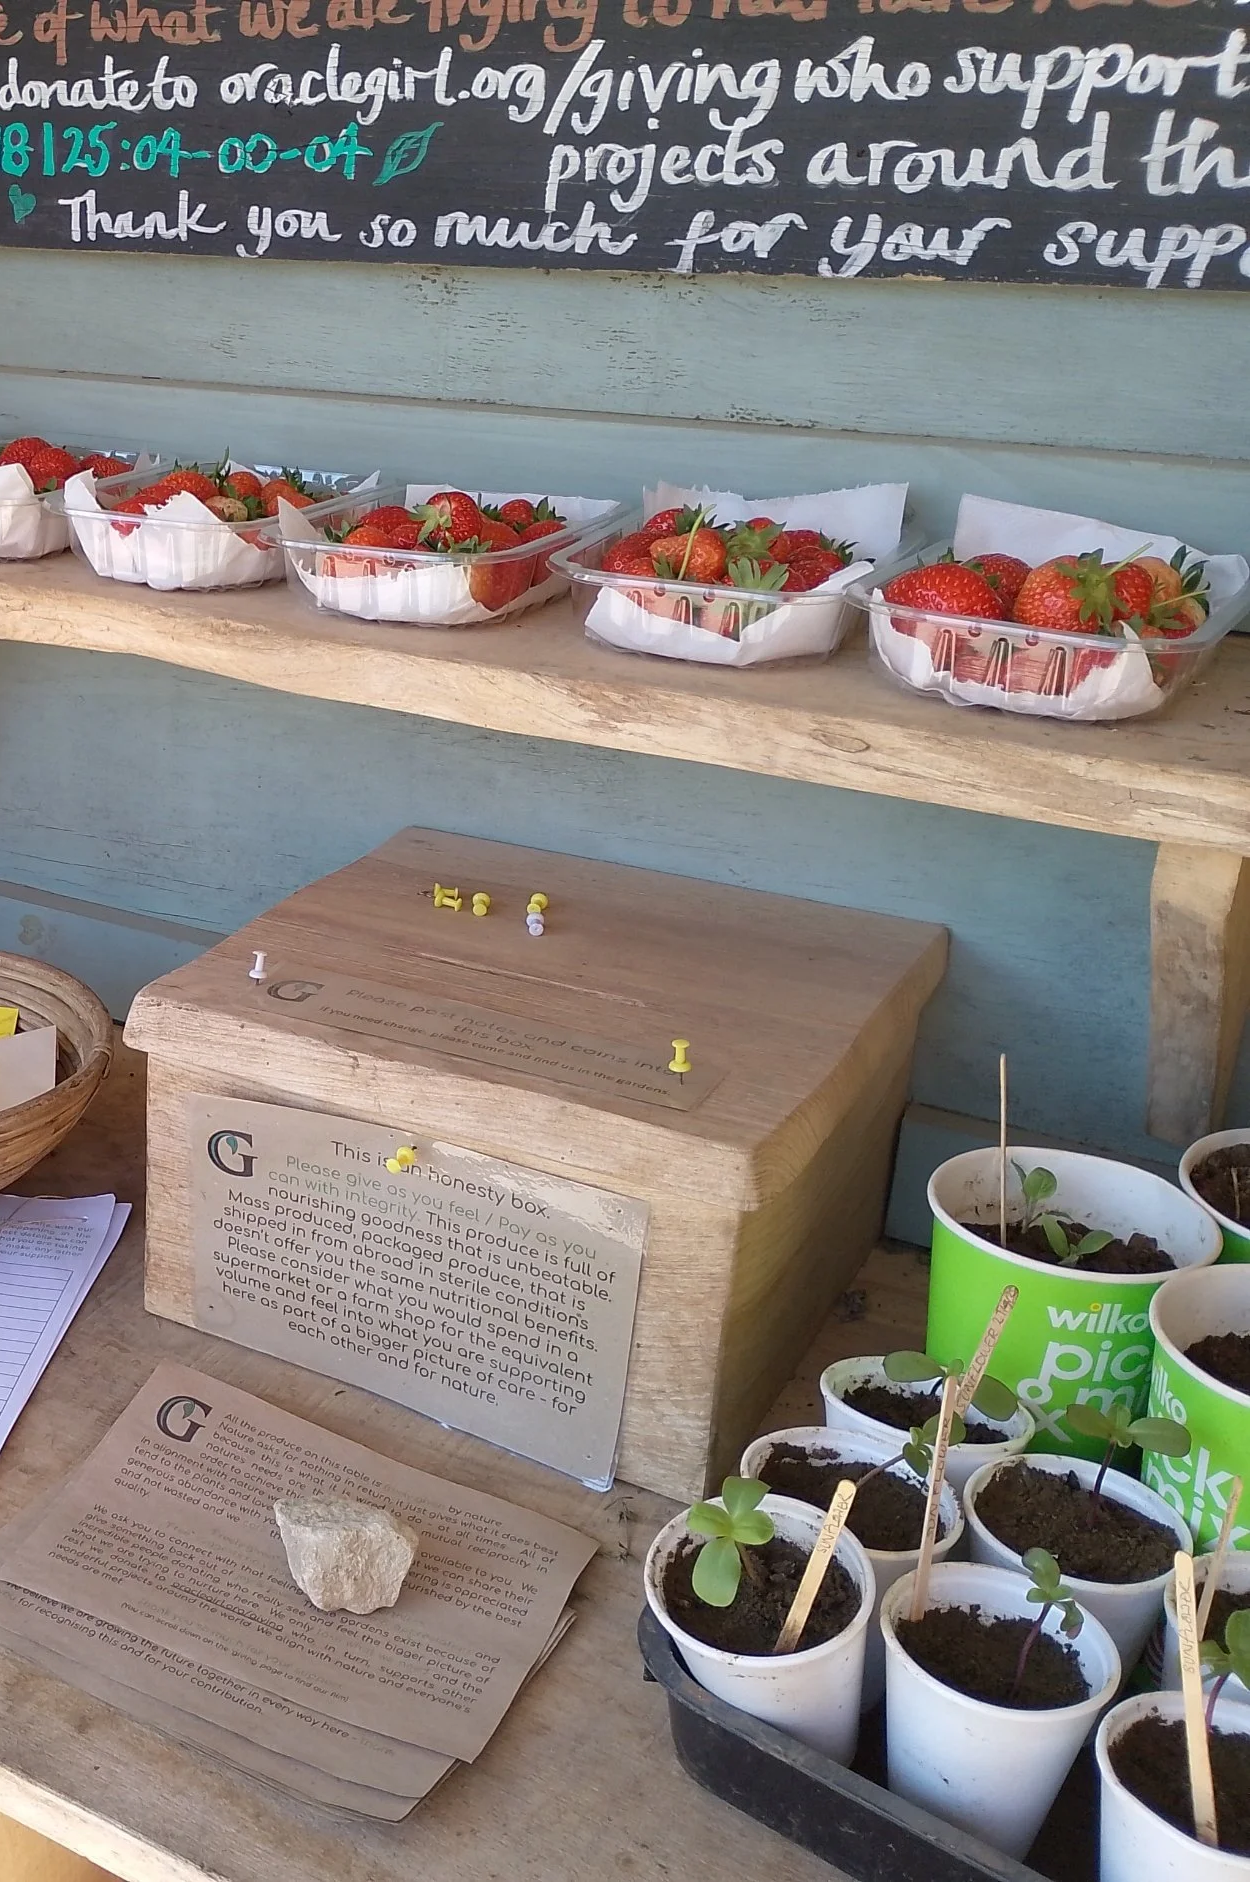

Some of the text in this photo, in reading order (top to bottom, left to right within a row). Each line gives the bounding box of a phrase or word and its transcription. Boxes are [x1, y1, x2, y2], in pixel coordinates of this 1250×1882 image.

[34, 0, 85, 66] of
[90, 0, 226, 45] what
[238, 0, 321, 40] we
[147, 55, 198, 109] to
[794, 34, 931, 104] who
[943, 28, 1250, 130] support
[544, 108, 1250, 213] projects around th
[59, 190, 226, 242] Thank
[237, 204, 343, 258] you
[359, 215, 416, 249] so
[433, 201, 639, 256] much
[665, 211, 808, 274] for
[818, 213, 1012, 278] your
[345, 989, 407, 1009] Please
[408, 1006, 456, 1020] post
[524, 1033, 567, 1047] and
[570, 1045, 628, 1064] coins
[453, 1025, 491, 1039] this
[268, 1170, 617, 1285] can with integrity. This produce is full of
[331, 1140, 371, 1163] This
[428, 1166, 505, 1206] honesty
[511, 1192, 551, 1219] box.
[223, 1204, 589, 1331] shipped in from abroad in sterile conditions
[228, 1188, 586, 1312] Mass produced, packaged produce, that is
[268, 1186, 612, 1303] nourishing goodness that is unbeatable.
[228, 1235, 579, 1364] Please consider what you would spend in a
[1047, 1303, 1150, 1334] wilko
[288, 1320, 499, 1407] each other and for nature.
[223, 1413, 239, 1424] All
[240, 1419, 257, 1433] the
[257, 1430, 302, 1453] produce
[304, 1450, 318, 1460] on
[320, 1456, 341, 1469] this
[342, 1465, 370, 1482] table
[371, 1479, 383, 1488] is
[18, 1597, 264, 1716] for recognising this and for your contribution.
[56, 1543, 109, 1568] wonderful
[108, 1565, 154, 1586] projects
[155, 1584, 198, 1604] around
[198, 1601, 218, 1613] the
[256, 1625, 272, 1637] We
[275, 1635, 305, 1652] align
[307, 1648, 332, 1663] with
[333, 1660, 375, 1680] nature
[378, 1676, 404, 1689] and
